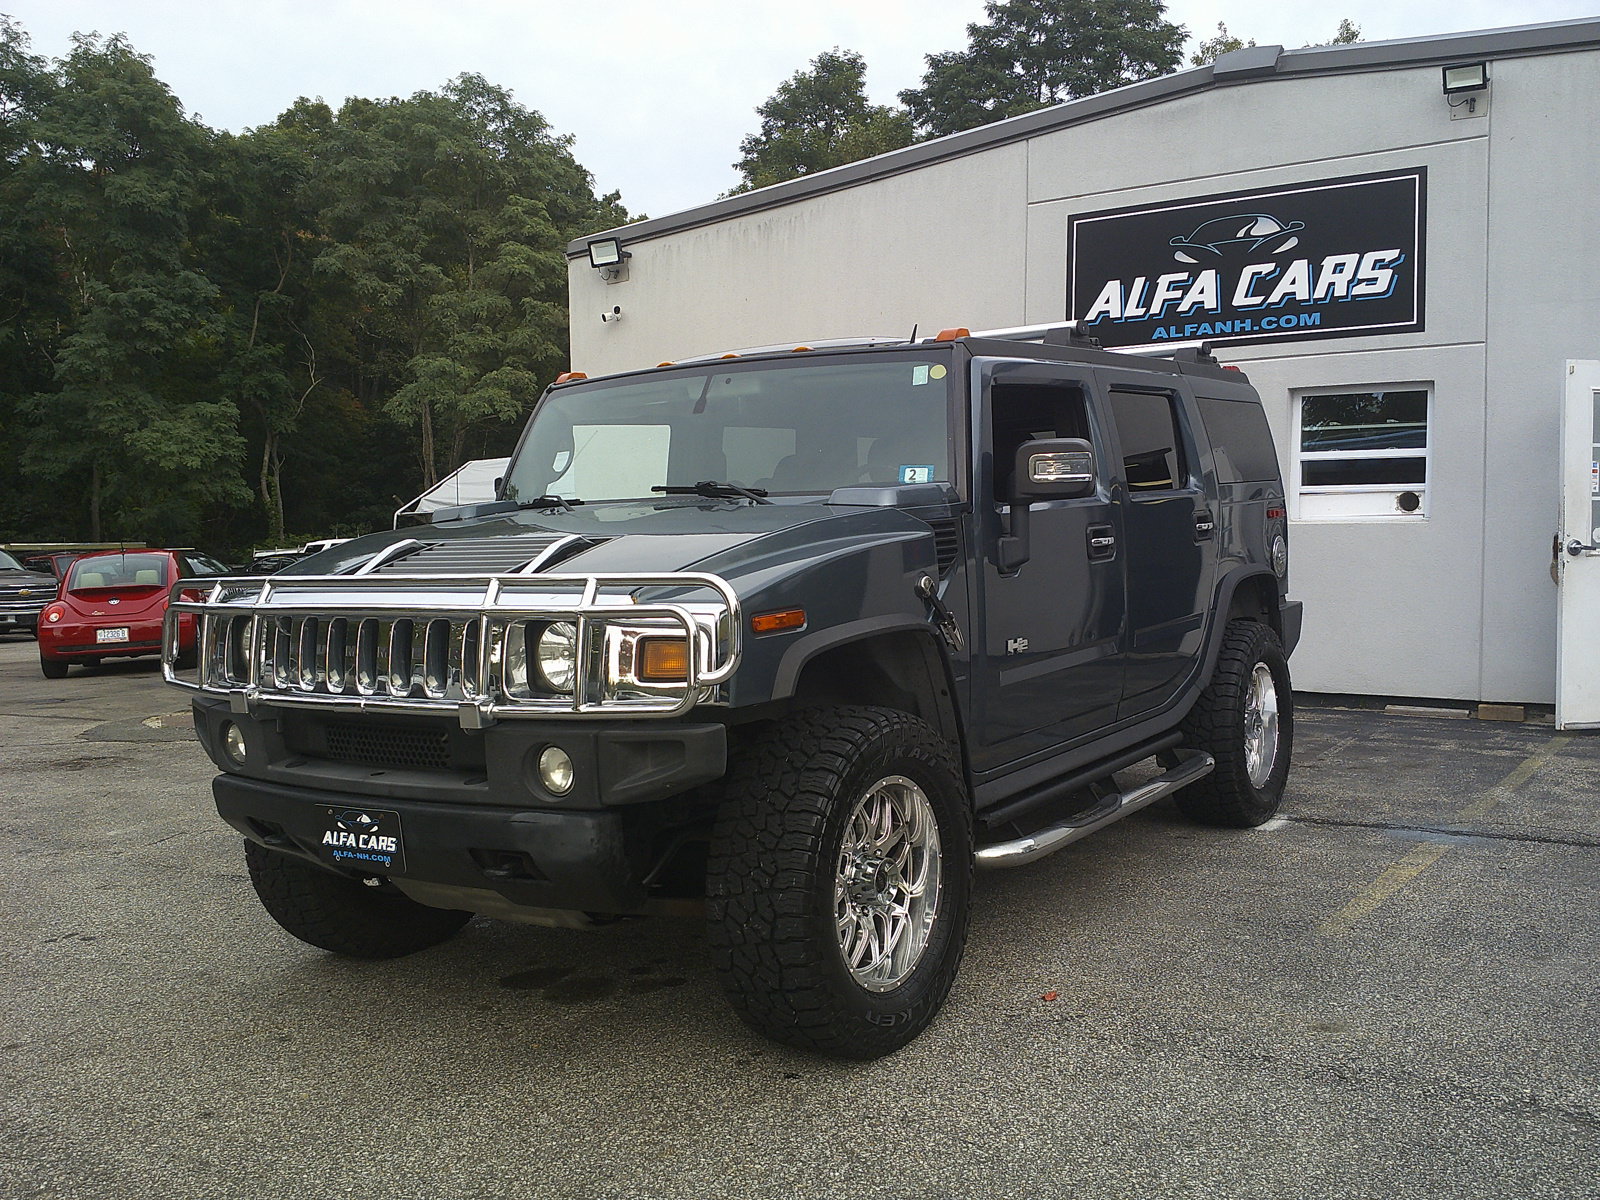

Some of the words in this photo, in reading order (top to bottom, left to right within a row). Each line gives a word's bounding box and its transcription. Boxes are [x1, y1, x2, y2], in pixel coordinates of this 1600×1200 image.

[1084, 269, 1220, 324] ALFA
[1232, 249, 1405, 311] CARS
[1151, 312, 1321, 340] ALFANH.COM
[908, 469, 917, 481] 2
[1007, 638, 1028, 655] H2
[322, 831, 357, 848] ALFA
[358, 834, 397, 852] CARS
[333, 850, 391, 863] ALFA-NH.COM
